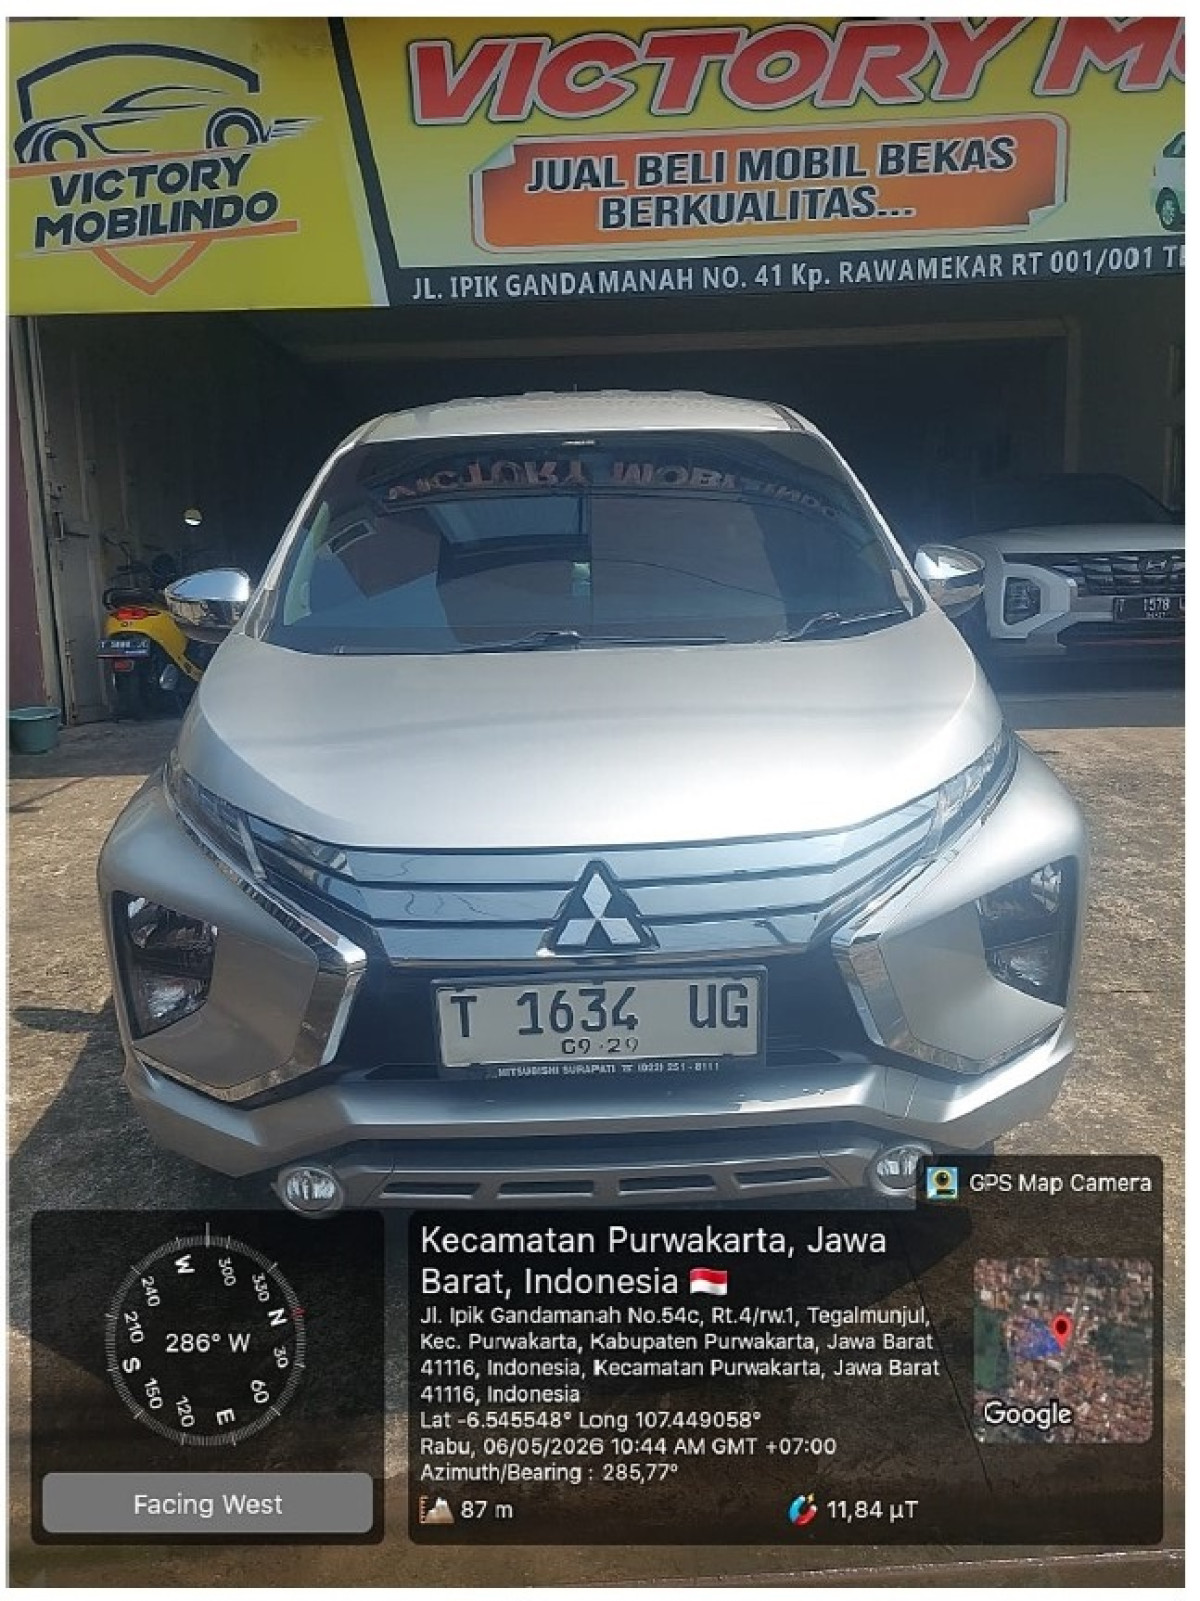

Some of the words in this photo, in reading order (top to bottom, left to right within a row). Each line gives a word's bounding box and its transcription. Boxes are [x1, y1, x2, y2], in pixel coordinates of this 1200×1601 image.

[408, 18, 1034, 126] VICTORY
[1033, 17, 1185, 96] M
[50, 154, 250, 206] VICTORY
[526, 155, 627, 194] JUAL
[636, 149, 726, 187] BELI
[736, 142, 874, 183] MOBIL
[880, 135, 1016, 175] BEKAS
[35, 191, 278, 248] MOBILINDO
[600, 184, 916, 230] BERKUALITAS...
[412, 276, 444, 301] JL.
[449, 273, 499, 299] IPIK
[506, 269, 694, 297] GANDAMANAH
[702, 265, 748, 289] NO.
[755, 263, 783, 288] 41
[792, 263, 832, 292] Kp.
[839, 254, 1004, 283] RAWAMEKAR
[1012, 252, 1043, 276] RT
[1051, 246, 1153, 275] 001/001
[450, 995, 478, 1038] T
[516, 986, 640, 1036] 1634
[689, 983, 749, 1029] UG
